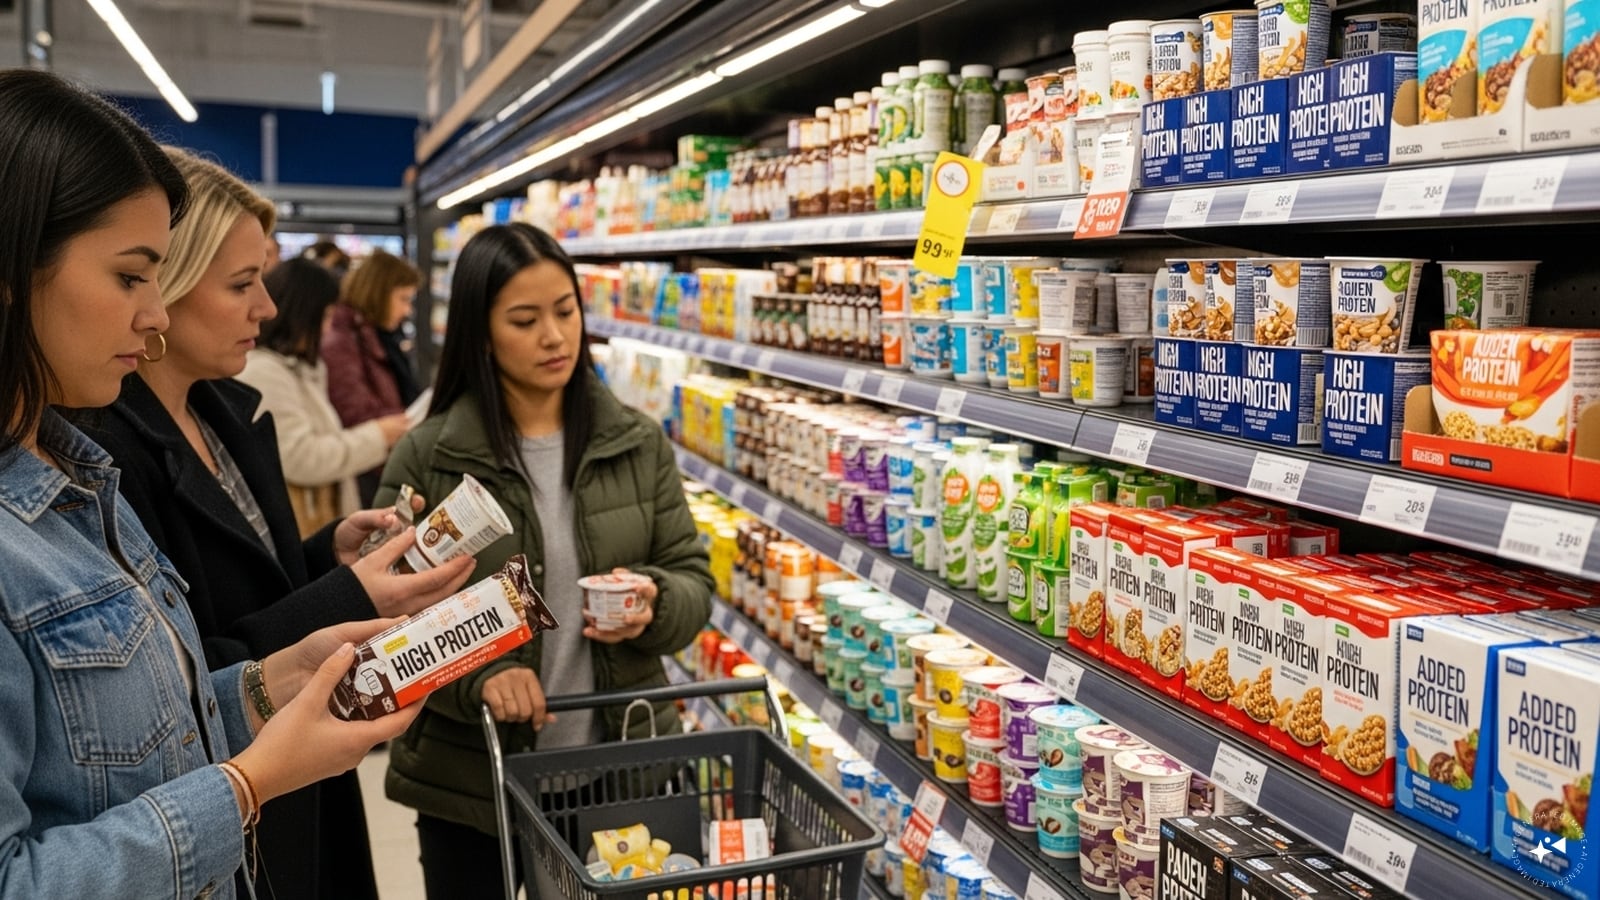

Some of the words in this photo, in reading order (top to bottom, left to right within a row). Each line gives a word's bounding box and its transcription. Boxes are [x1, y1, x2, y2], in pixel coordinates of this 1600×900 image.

[1339, 61, 1370, 97] HIGH
[1330, 93, 1385, 133] PROTEIN
[922, 239, 942, 258] 99
[1325, 389, 1384, 426] PROTEIN
[390, 641, 437, 681] HIGH
[434, 606, 505, 660] PROTEIN
[1327, 655, 1379, 700] PROTEIN
[1417, 655, 1466, 694] ADDED
[1408, 679, 1469, 728] PROTEIN
[1519, 691, 1577, 734] ADDED
[1508, 716, 1581, 772] PROTEIN
